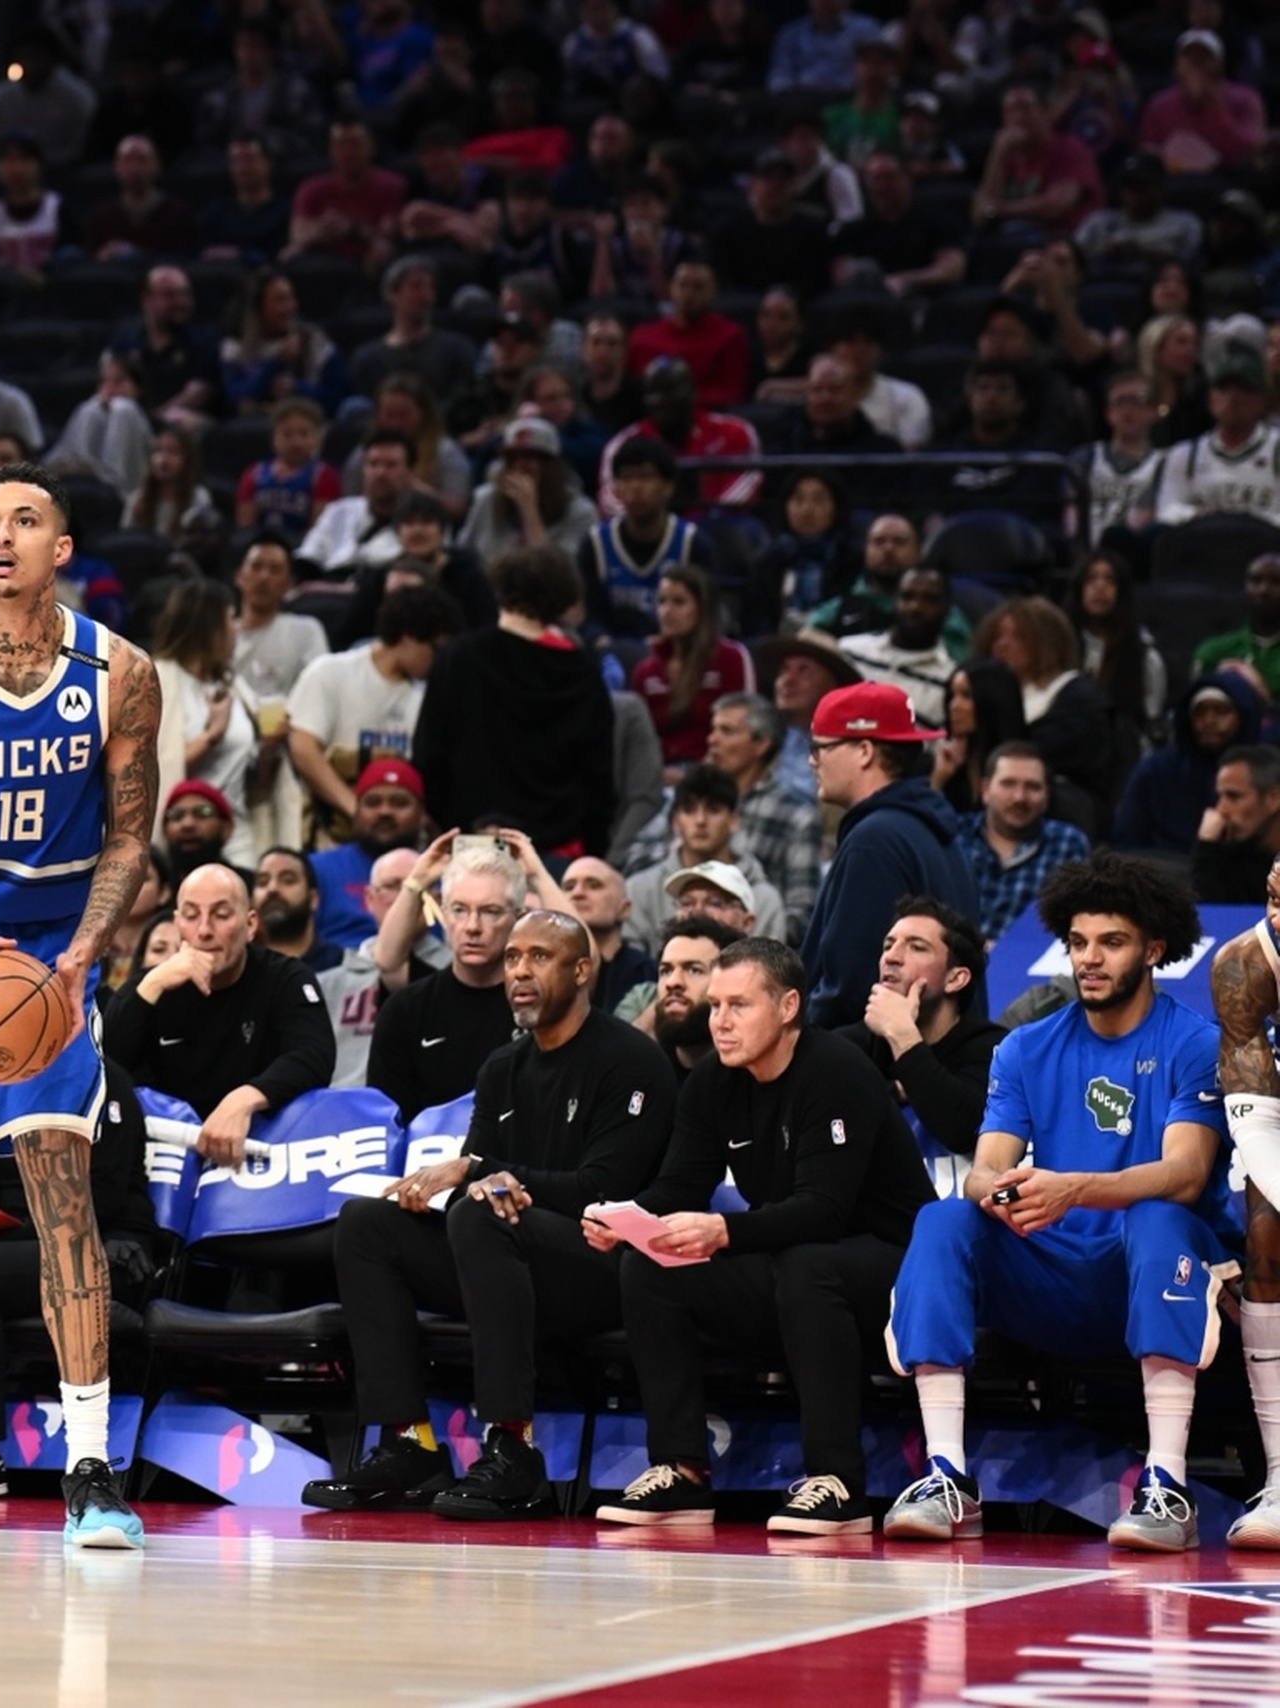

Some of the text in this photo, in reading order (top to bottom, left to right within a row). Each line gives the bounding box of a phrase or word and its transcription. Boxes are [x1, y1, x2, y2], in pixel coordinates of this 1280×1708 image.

[1091, 1086, 1125, 1117] BUCKS
[1229, 1103, 1254, 1120] KP
[194, 1126, 387, 1198] URE
